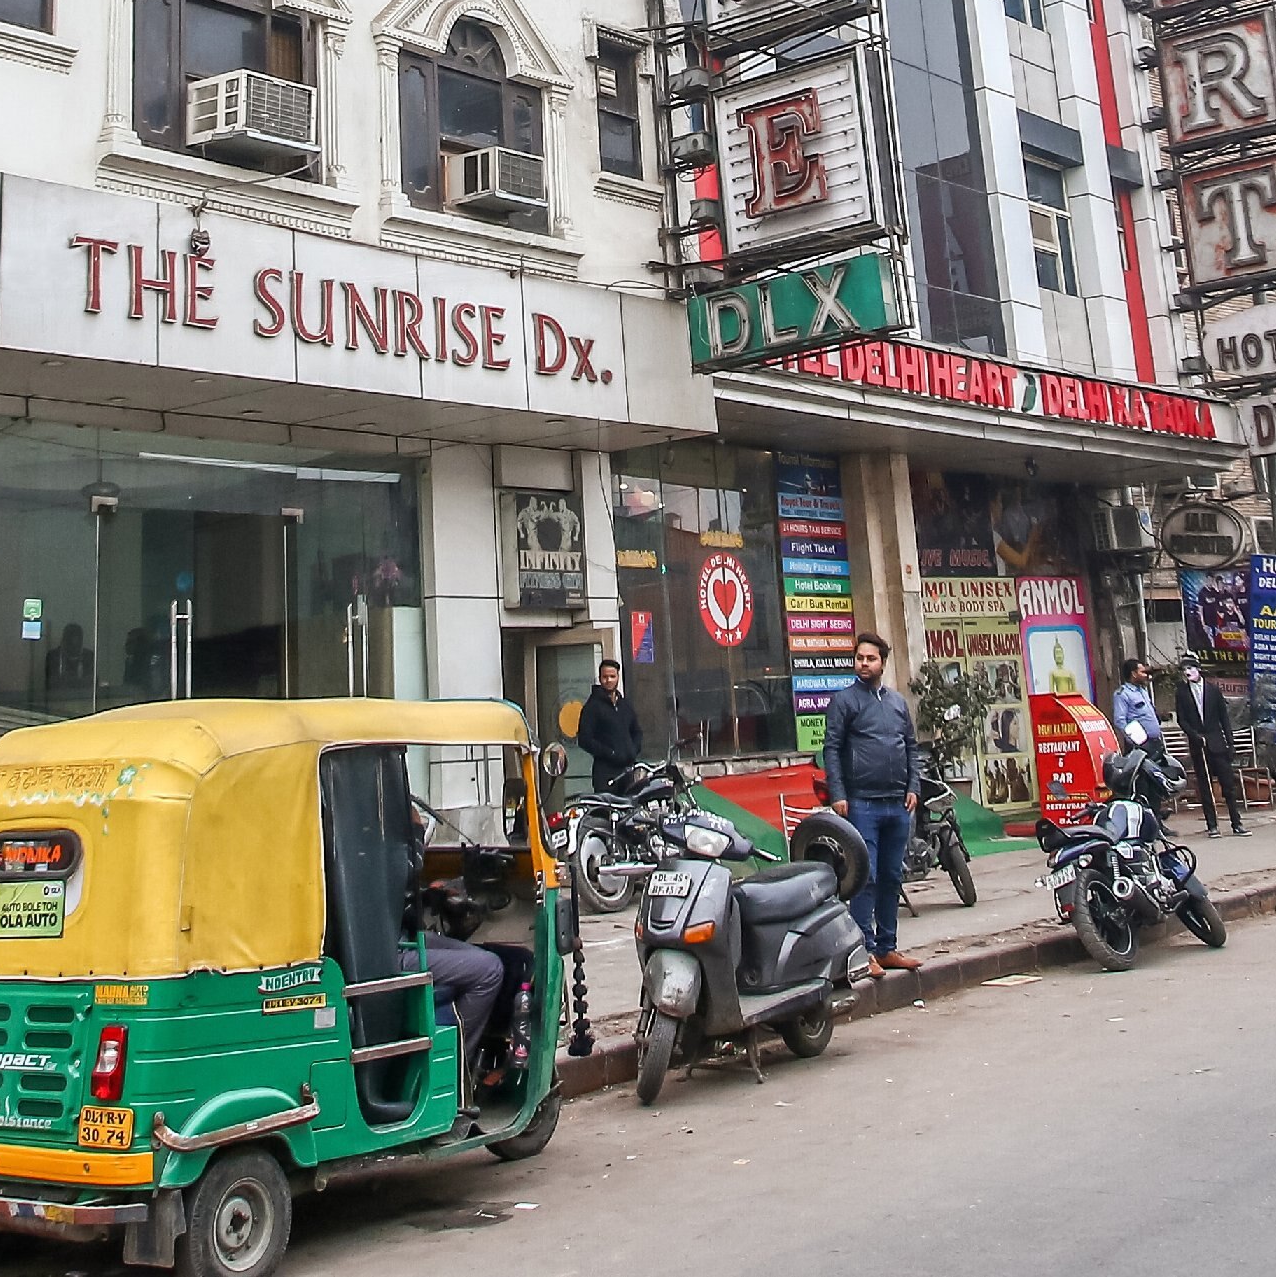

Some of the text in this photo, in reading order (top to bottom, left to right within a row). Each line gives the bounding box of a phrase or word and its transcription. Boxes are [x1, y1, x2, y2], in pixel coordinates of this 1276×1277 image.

[69, 234, 220, 330] THE
[252, 268, 512, 371] SUNRISE
[707, 263, 861, 361] DLX
[841, 340, 927, 395] DELHI
[927, 351, 1018, 409] HEART
[1041, 374, 1109, 423] DELHI
[790, 523, 808, 533] HOURS
[809, 525, 820, 534] TAXI
[821, 526, 841, 535] SERVICE
[791, 543, 836, 554] Flight Ticket
[921, 549, 942, 567] IVE
[789, 561, 842, 574] Holiday Packages
[699, 567, 712, 611] HOTEL
[794, 580, 842, 593] Hotel Booking
[921, 581, 1013, 598] MOL UNISEX
[790, 599, 804, 609] Car
[809, 599, 823, 609] Bus
[826, 600, 849, 609] Rental
[1018, 579, 1085, 620] ANMOL
[923, 600, 1006, 613] ALON & BODY SPA
[791, 619, 852, 629] DELHI SIGHT SEEING
[925, 629, 964, 658] MOL
[966, 633, 993, 657] UNISEX
[800, 719, 823, 727] MONEY
[1038, 740, 1080, 754] RESTAURANT
[1046, 803, 1086, 811] RESTAURAN
[2, 901, 58, 912] AUTO BOLE TOH
[0, 913, 58, 928] OLA AUTO
